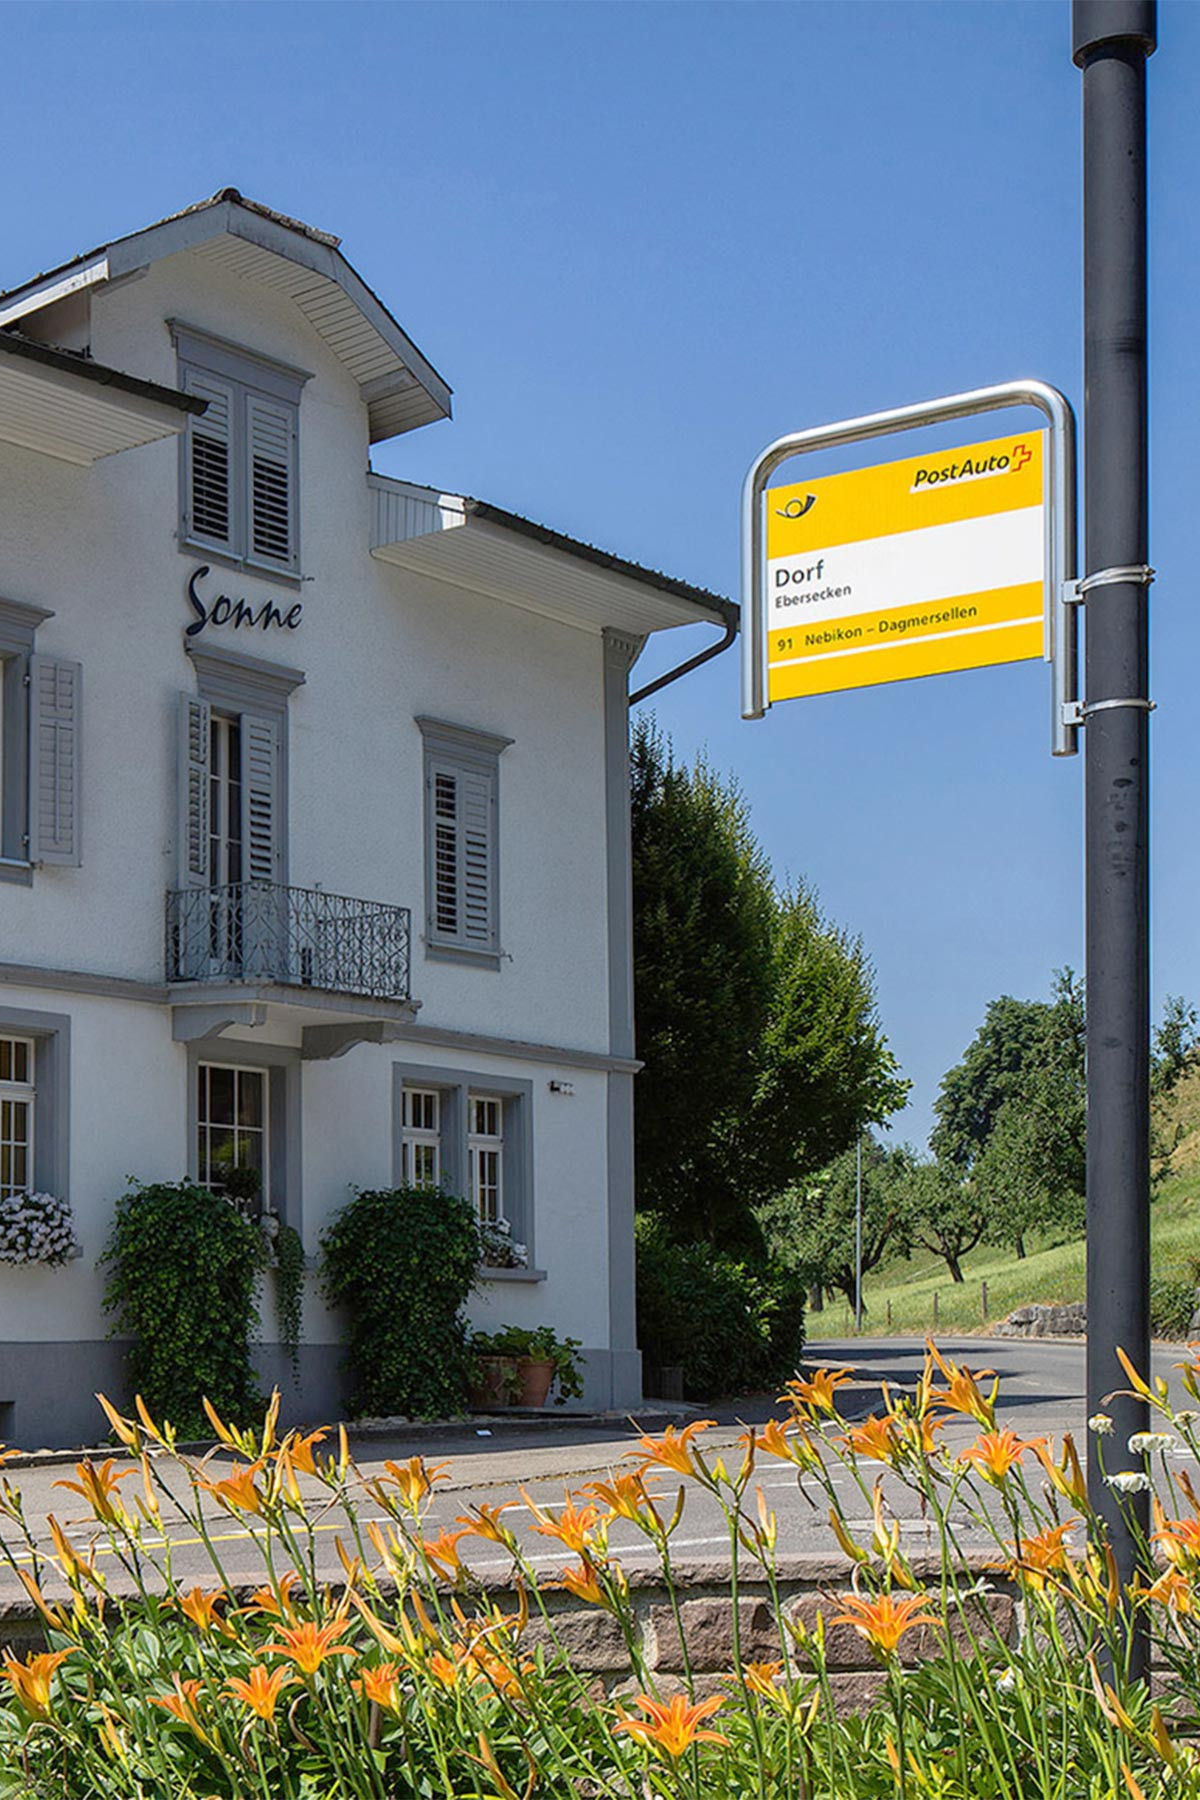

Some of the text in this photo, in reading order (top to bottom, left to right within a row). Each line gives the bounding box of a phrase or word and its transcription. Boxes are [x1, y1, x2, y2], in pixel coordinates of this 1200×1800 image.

[914, 456, 1010, 487] PostAuto
[775, 559, 824, 588] Dorf
[185, 566, 302, 636] Sonne
[775, 585, 852, 609] Ebersecken
[777, 638, 793, 652] 91
[805, 627, 863, 646] Nebikon
[878, 606, 978, 633] Dagmersellen
